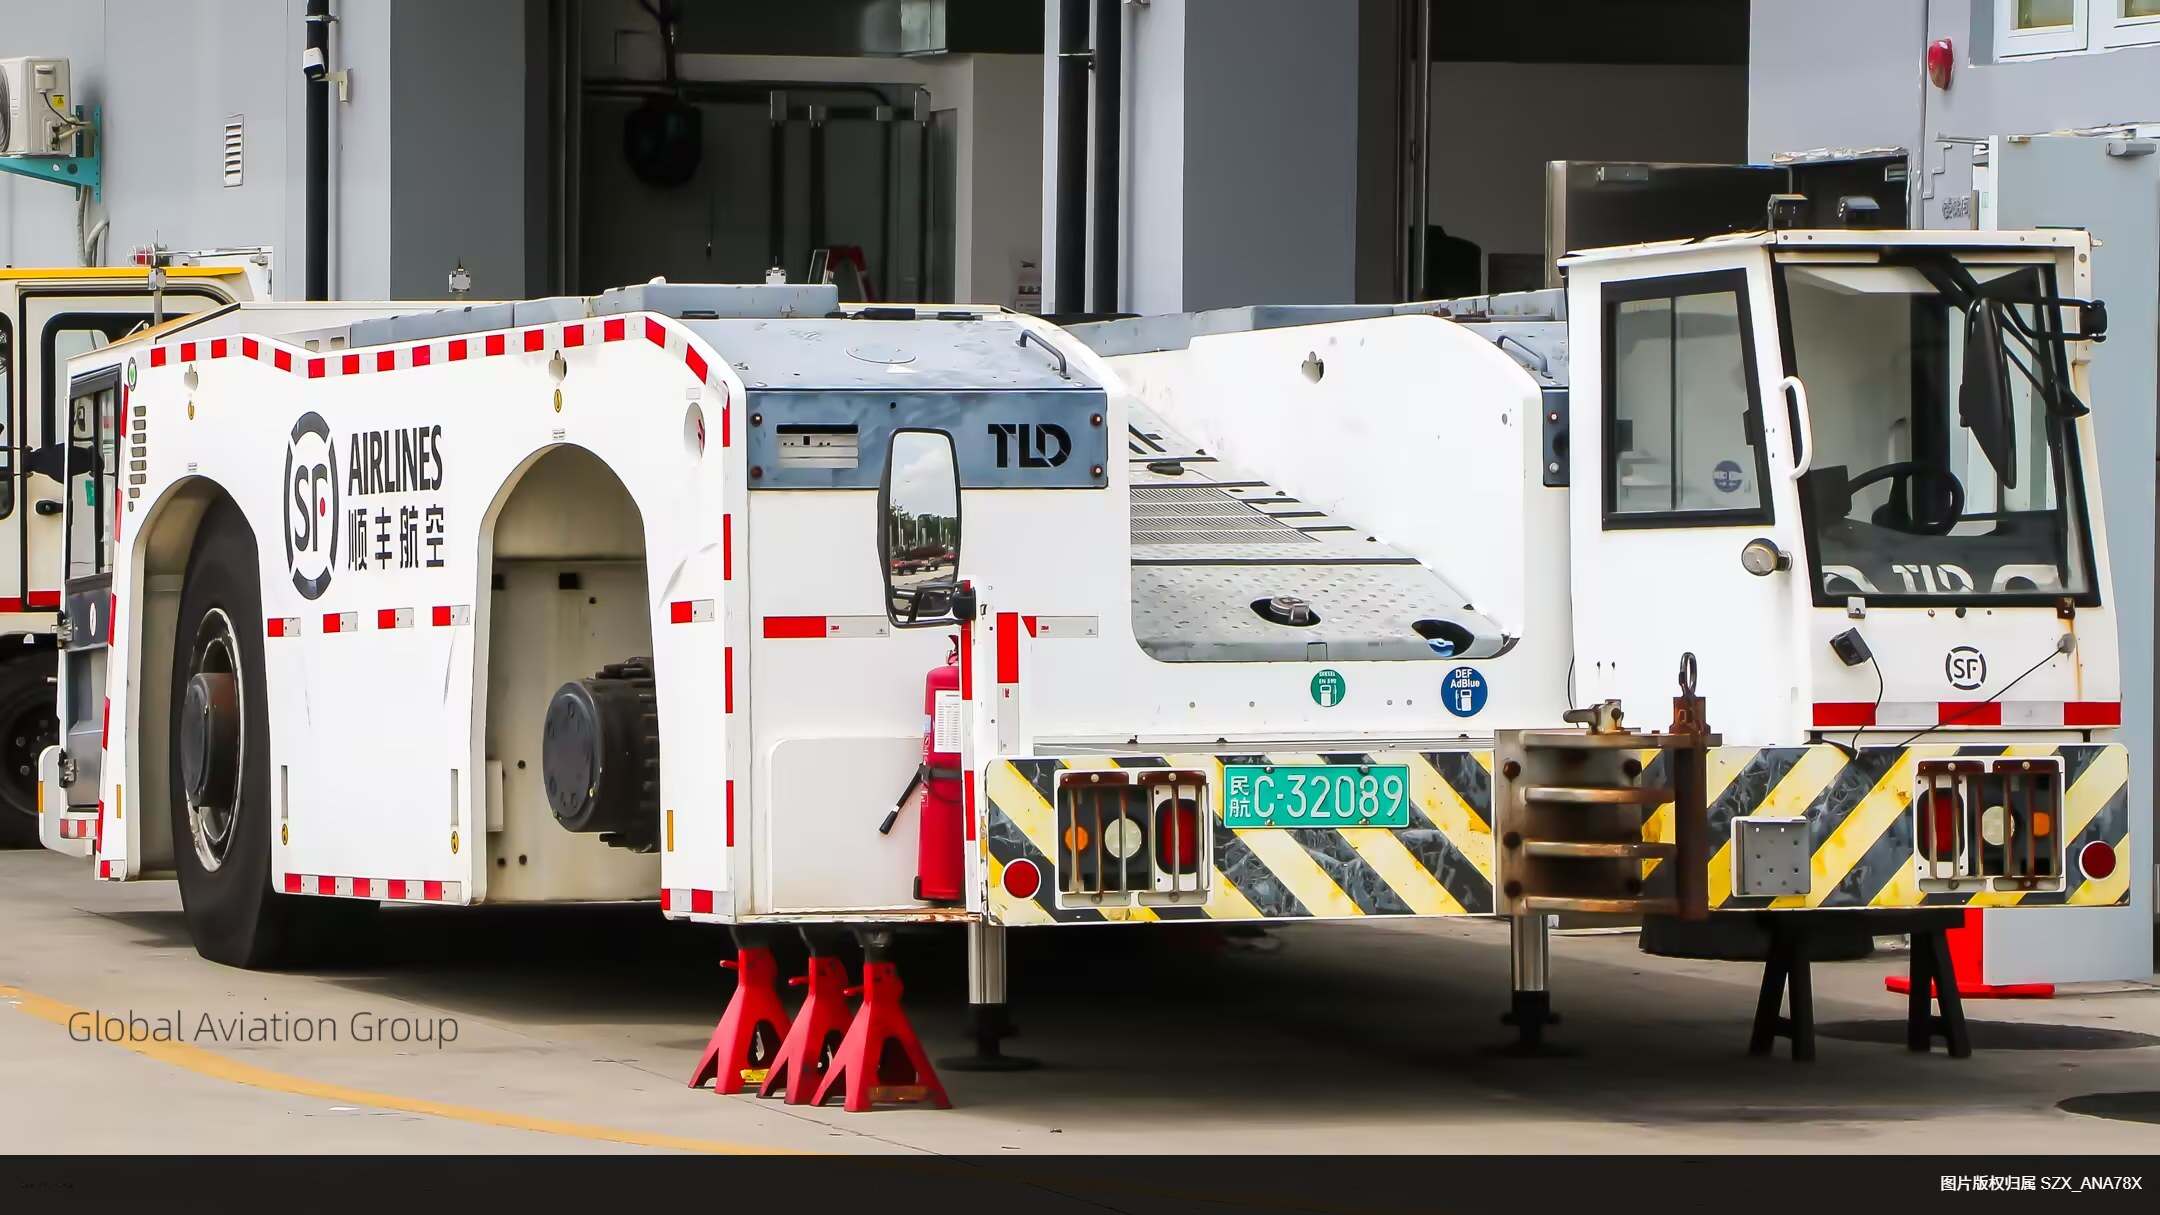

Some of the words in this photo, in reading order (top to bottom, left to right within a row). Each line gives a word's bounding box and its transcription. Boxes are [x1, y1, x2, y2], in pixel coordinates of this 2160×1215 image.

[348, 424, 443, 496] AIRLINES
[987, 423, 1072, 468] TLD
[294, 463, 329, 552] SF
[348, 503, 444, 571] 顺丰航空
[1450, 679, 1480, 688] AdBlue
[1455, 669, 1472, 679] DEF
[1953, 658, 1978, 679] SF
[1229, 775, 1250, 818] 民航
